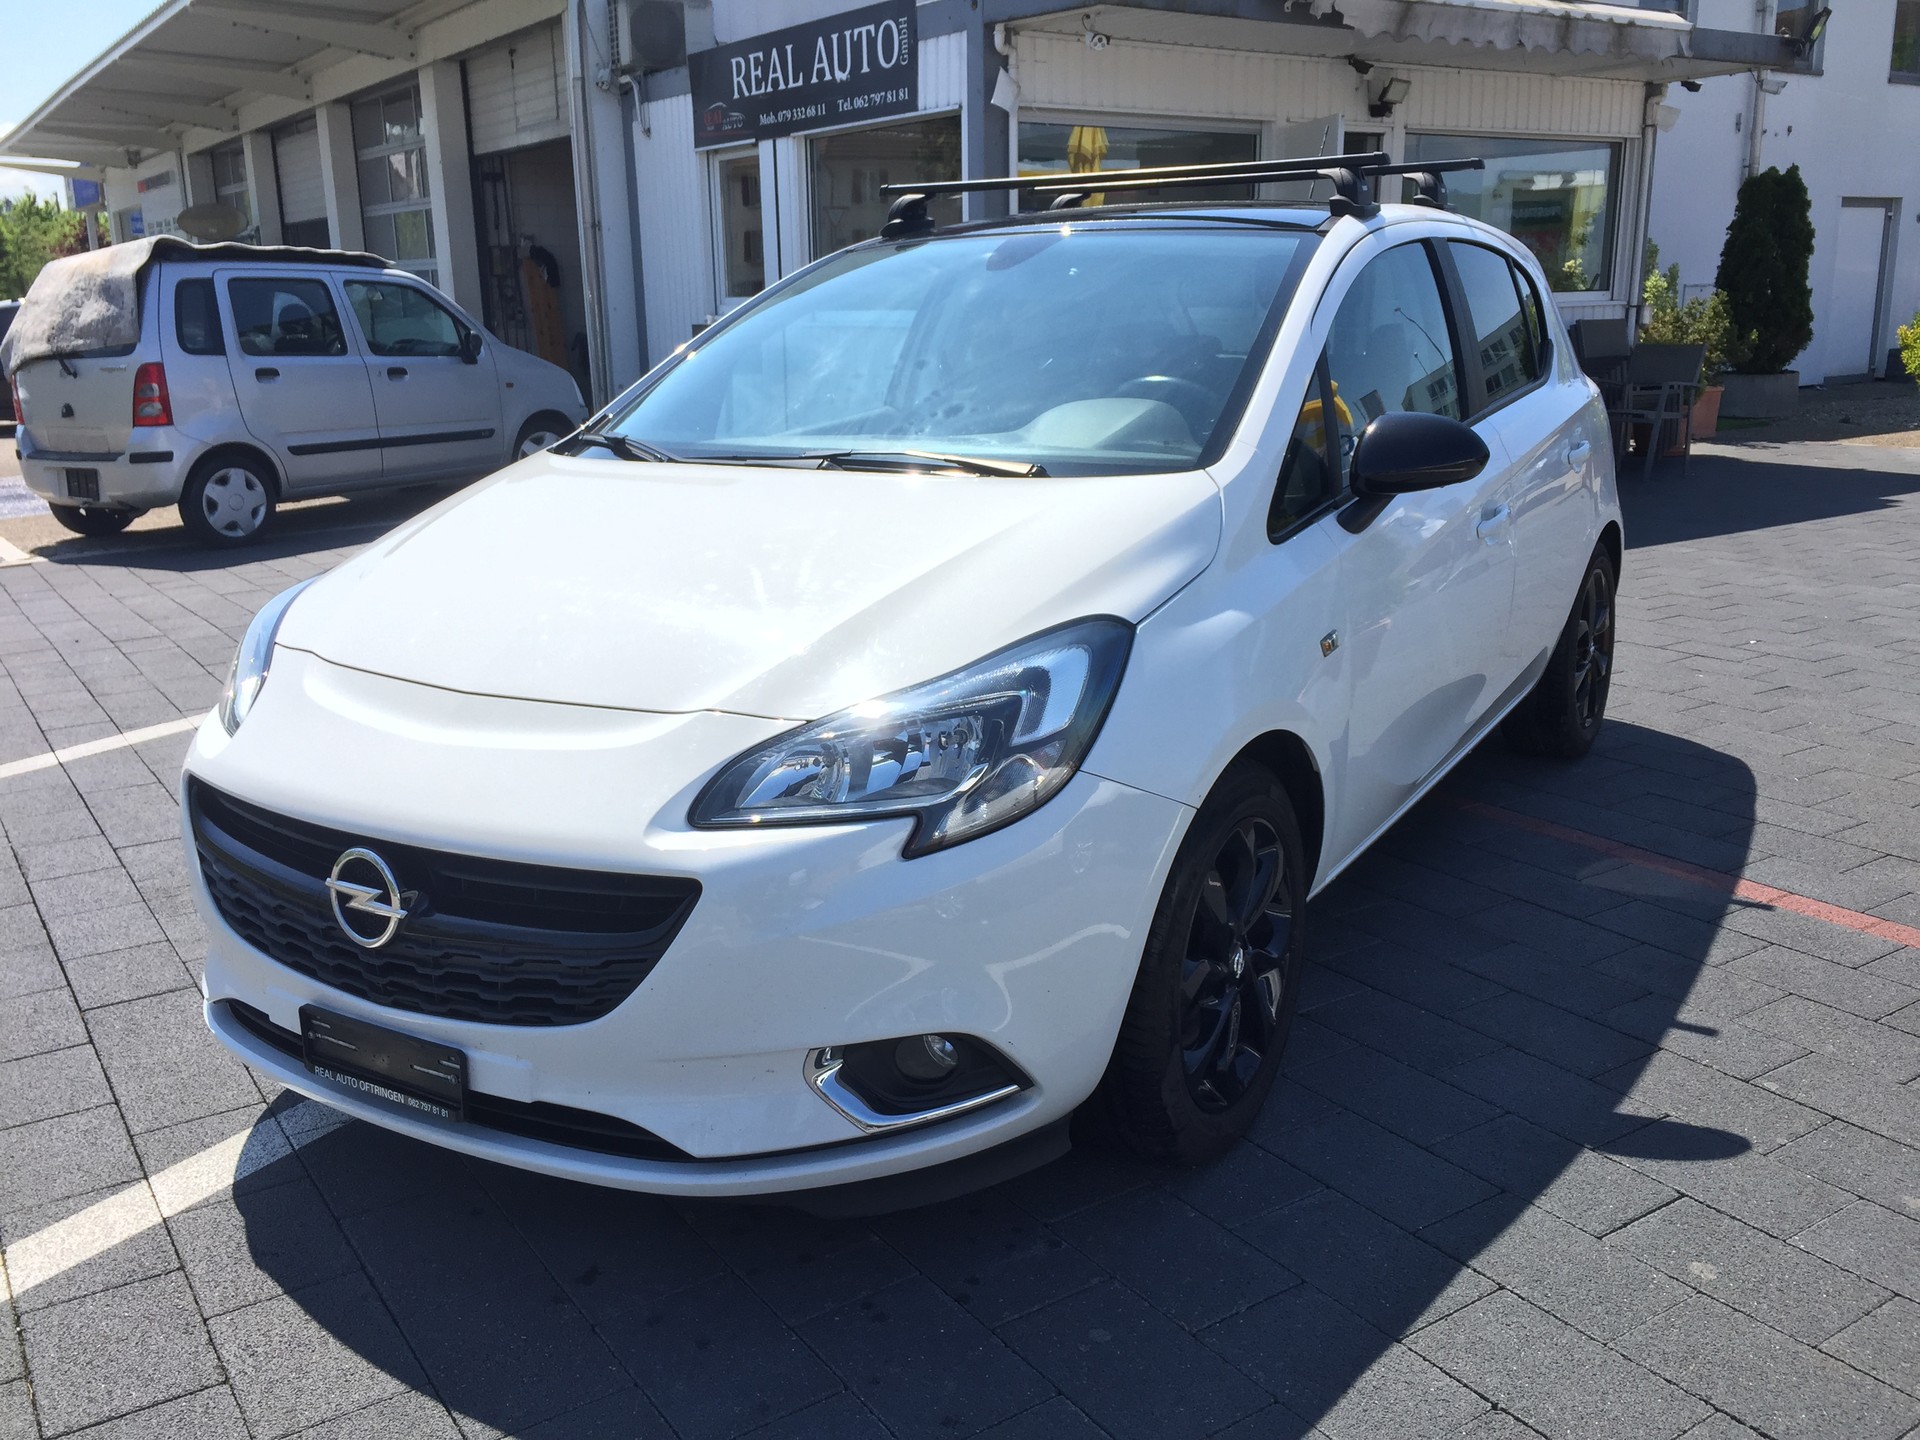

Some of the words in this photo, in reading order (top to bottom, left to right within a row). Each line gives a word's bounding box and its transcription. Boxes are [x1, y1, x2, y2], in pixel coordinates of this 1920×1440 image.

[730, 44, 803, 99] REAL
[811, 19, 899, 83] AUTO
[899, 16, 908, 66] GmbH
[777, 109, 792, 123] 079
[792, 106, 805, 121] 332
[806, 104, 816, 118] 68
[817, 103, 826, 116] 11
[853, 95, 869, 108] 062
[870, 92, 885, 106] 797
[886, 89, 896, 103] 81
[898, 87, 909, 101] 81
[314, 1065, 335, 1081] REAL
[336, 1073, 358, 1088] AUTO
[359, 1080, 405, 1104] OFTRINGEN
[420, 1101, 431, 1112] 797
